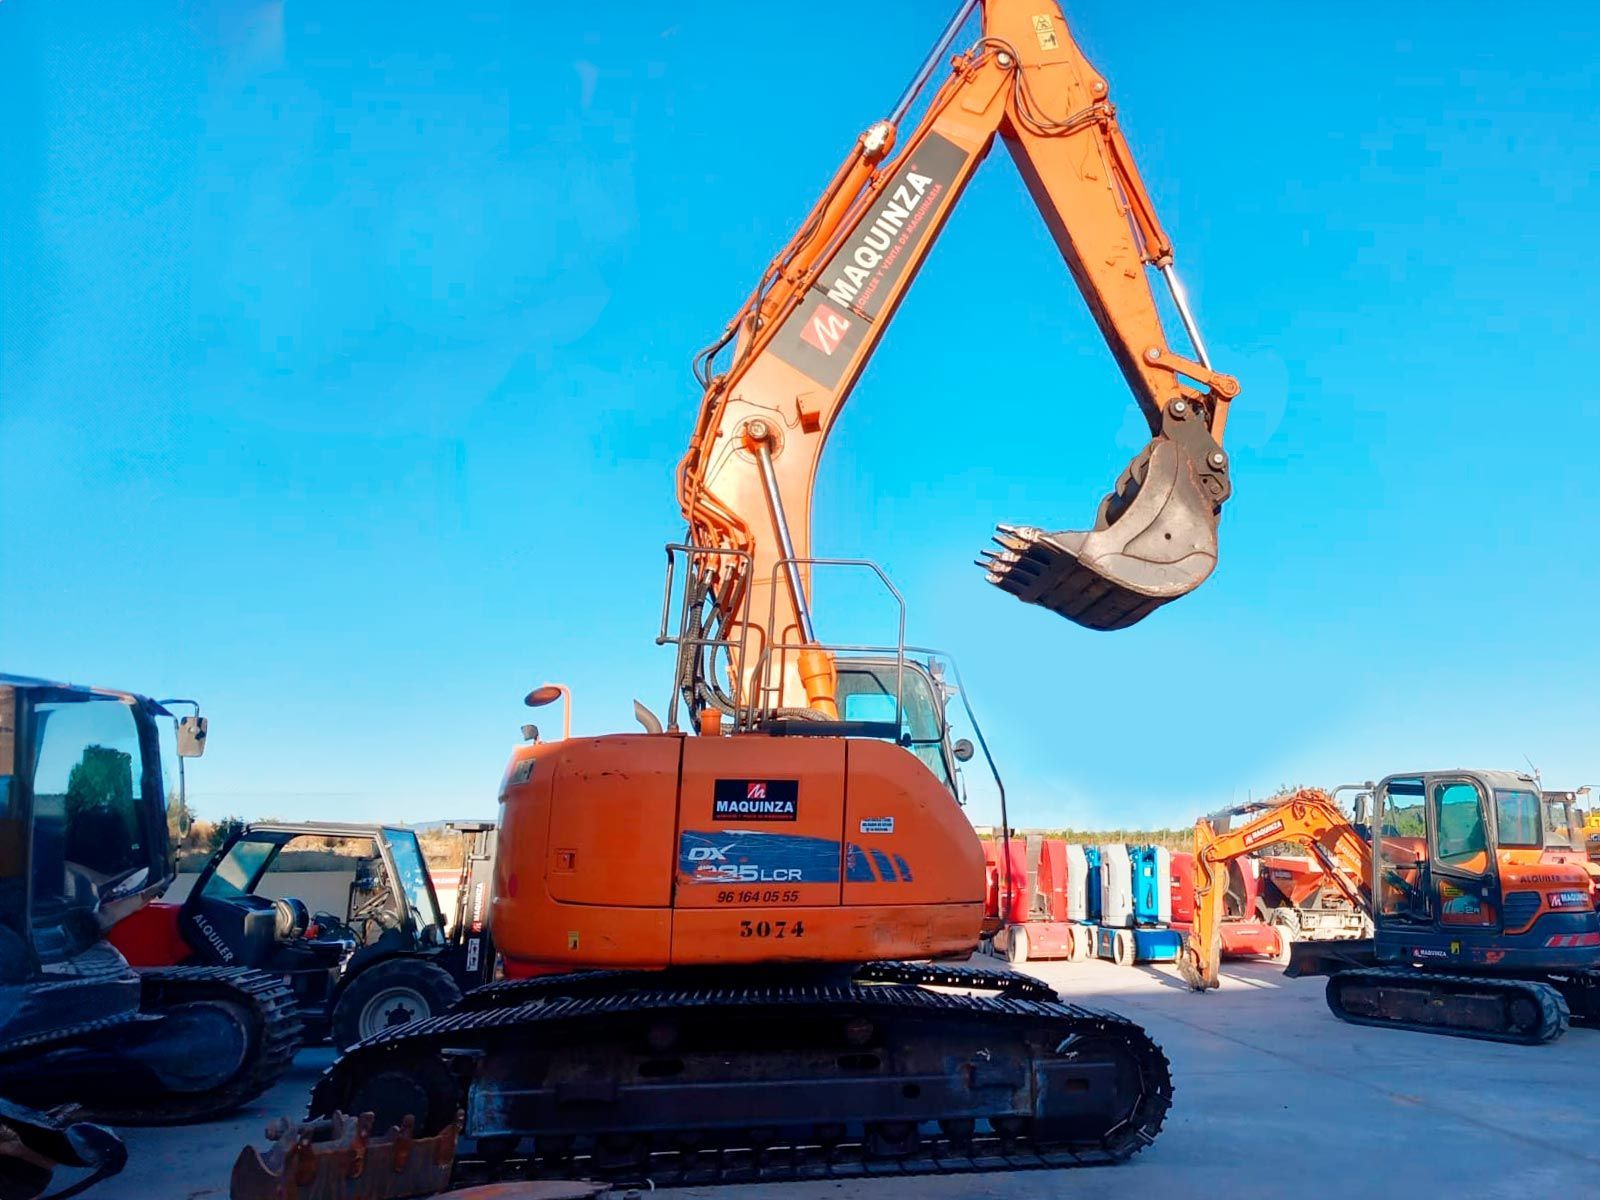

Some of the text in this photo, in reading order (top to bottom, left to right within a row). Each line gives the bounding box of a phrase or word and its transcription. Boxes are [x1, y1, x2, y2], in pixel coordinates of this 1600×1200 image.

[882, 245, 901, 269] VENTA
[900, 232, 909, 245] DE
[907, 184, 943, 233] MAQUINARIA
[827, 171, 933, 308] MAQUINZA
[716, 801, 794, 813] MAQUINZA
[688, 844, 736, 860] DX
[717, 891, 799, 903] 96 164 05 55
[193, 914, 234, 962] ALQUILER
[740, 921, 805, 938] 3074
